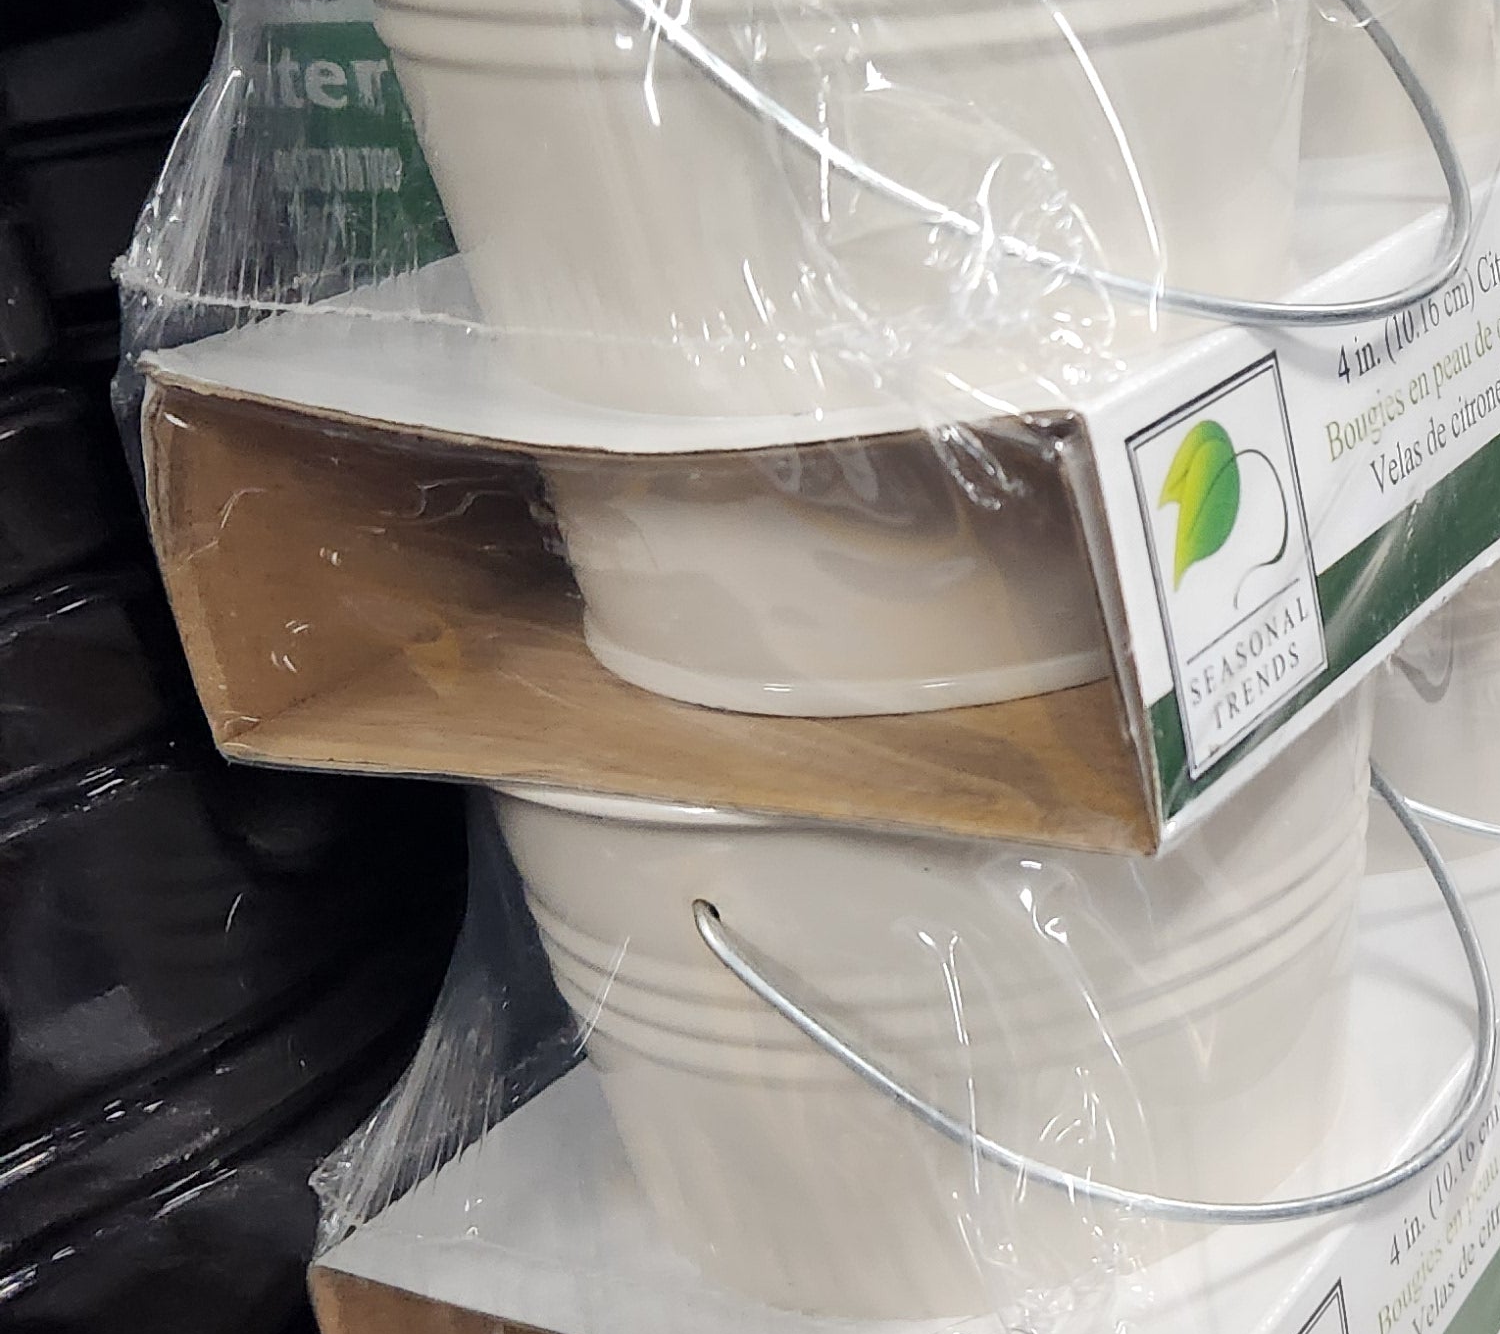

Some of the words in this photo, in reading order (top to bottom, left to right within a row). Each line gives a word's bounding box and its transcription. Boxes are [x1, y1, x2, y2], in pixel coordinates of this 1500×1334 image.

[1338, 344, 1351, 385] 4
[1353, 335, 1382, 377] in.
[1384, 297, 1441, 365] (10.16
[1443, 267, 1475, 316] cm)
[1324, 387, 1405, 463] Bougies
[1408, 376, 1431, 406] en
[1432, 341, 1472, 400] peau
[1474, 319, 1493, 359] de
[1369, 441, 1424, 494] Velas
[1426, 416, 1447, 456] de
[1189, 596, 1309, 706] SEASONAL
[1213, 641, 1299, 730] TRENDS
[1390, 1234, 1401, 1267] 4
[1403, 1214, 1427, 1251] in.
[1427, 1139, 1477, 1220] (10.16
[1446, 1207, 1462, 1244] en
[1458, 1241, 1476, 1280] de
